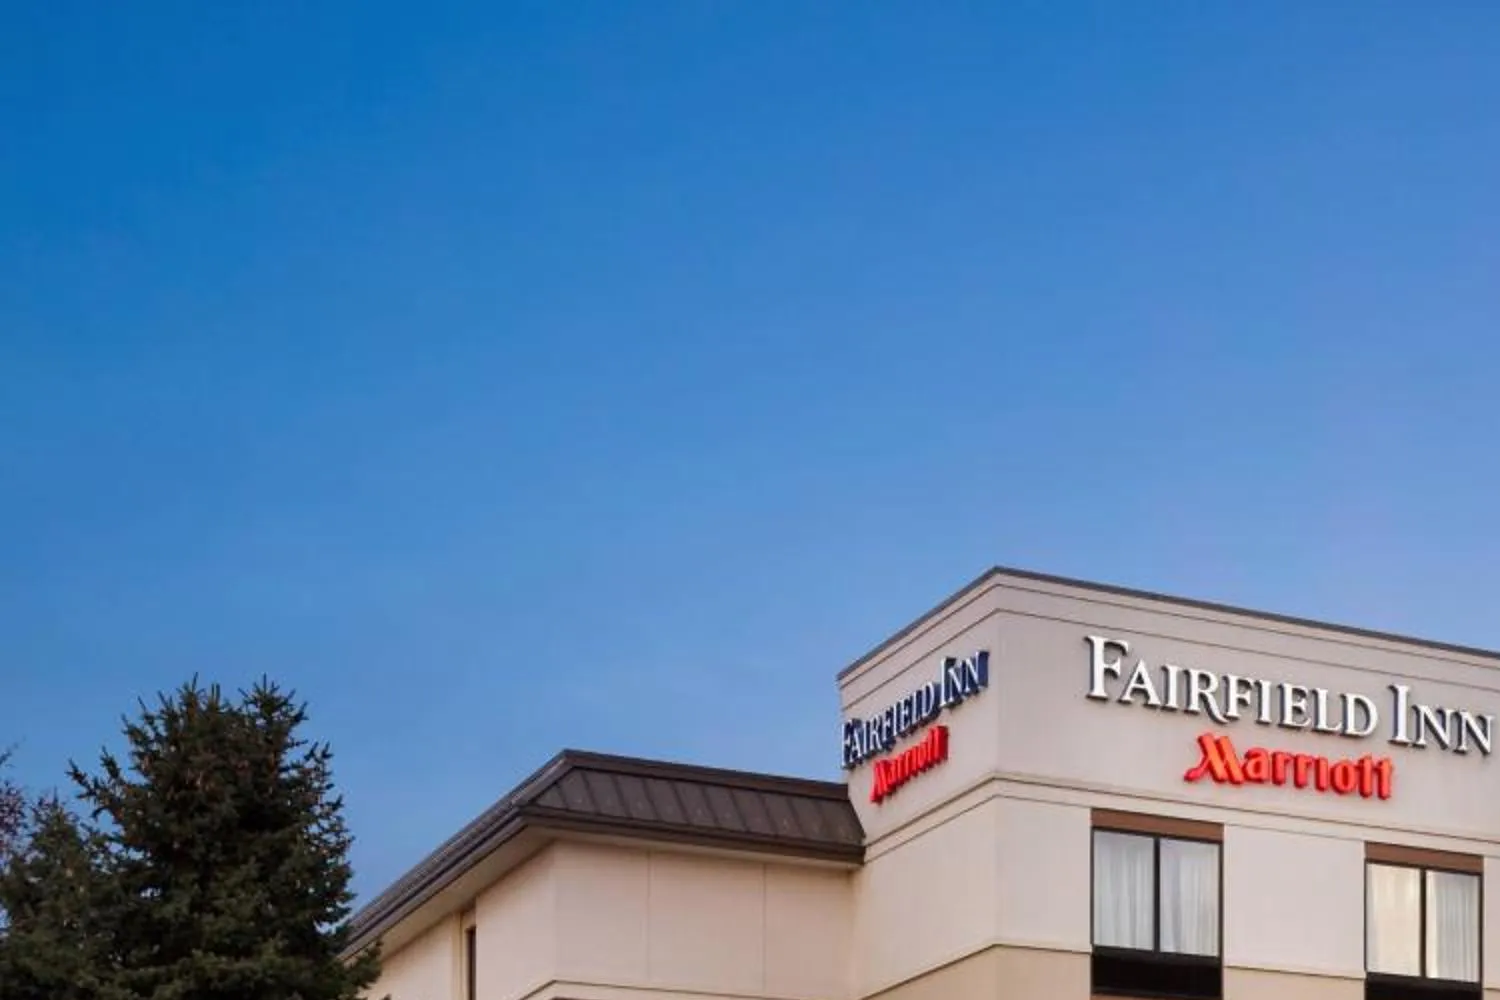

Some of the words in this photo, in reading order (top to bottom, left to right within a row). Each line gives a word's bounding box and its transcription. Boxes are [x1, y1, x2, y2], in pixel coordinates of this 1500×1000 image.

[940, 651, 990, 708] INN
[1084, 635, 1380, 738] FAIRFIELD
[1387, 682, 1496, 756] INN
[1184, 732, 1395, 800] Marriott
